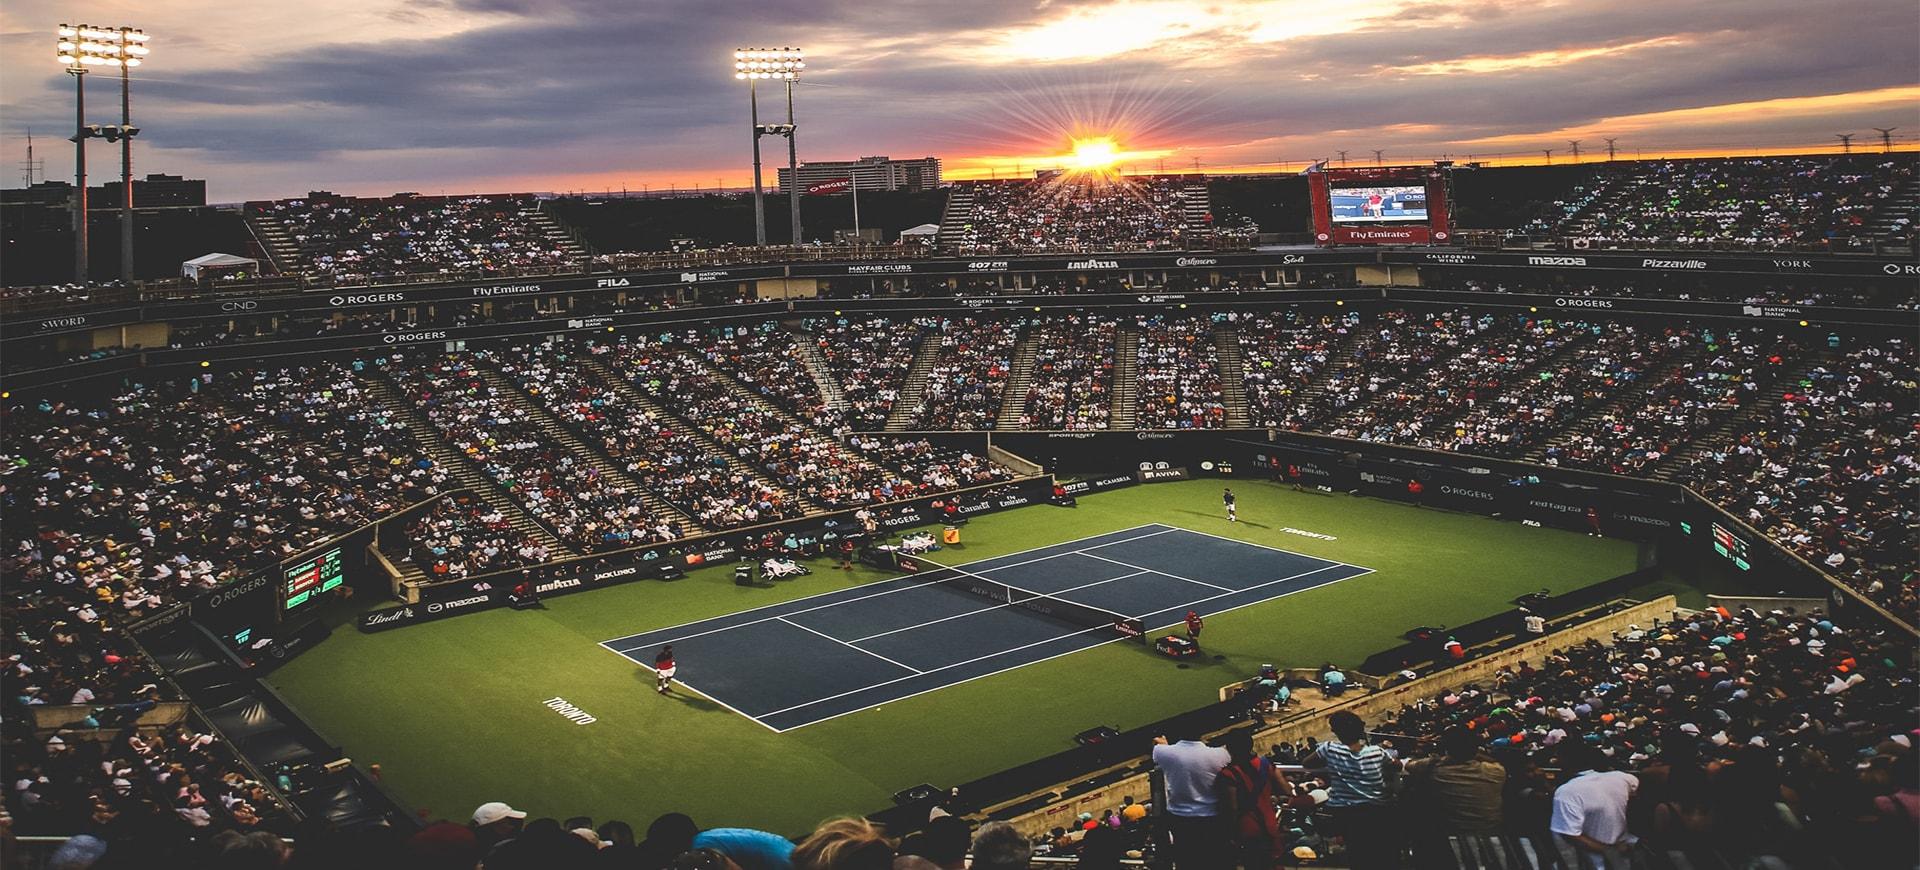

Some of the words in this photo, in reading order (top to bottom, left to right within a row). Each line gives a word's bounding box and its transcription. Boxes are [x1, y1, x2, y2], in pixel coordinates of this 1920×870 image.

[1350, 231, 1367, 240] Fly
[1367, 230, 1411, 239] Emirates
[968, 261, 991, 269] 407
[1067, 259, 1119, 270] LAVAZZA
[1283, 254, 1305, 265] Stoli
[1528, 256, 1587, 267] mazda
[1642, 258, 1707, 270] Pizzaville
[1773, 259, 1812, 268] YORK
[698, 270, 729, 279] NATIONAL
[597, 278, 630, 288] FILA
[473, 286, 491, 297] Fly
[492, 283, 541, 295] Emirates
[347, 292, 404, 304] ROGERS
[1569, 299, 1613, 308] ROGERS
[221, 300, 257, 312] CND
[1764, 306, 1801, 314] NATIONAL
[42, 316, 86, 330] SWORD
[584, 316, 613, 324] NATIONAL
[398, 330, 446, 342] ROGERS
[1155, 470, 1181, 478] AVIVA
[1317, 484, 1332, 493] FILA
[1453, 487, 1494, 501] ROGERS
[958, 501, 990, 514] Canada
[884, 514, 921, 526] ROGERS
[1522, 519, 1541, 527] FILA
[1280, 526, 1338, 541] TORONTO
[704, 547, 735, 557] NATIONAL
[594, 571, 614, 581] JACK
[223, 575, 267, 602] ROGERS
[536, 578, 581, 593] LAVAZZA
[445, 594, 489, 609] mazda
[365, 609, 404, 626] Lindt
[542, 696, 598, 726] TORONTO
